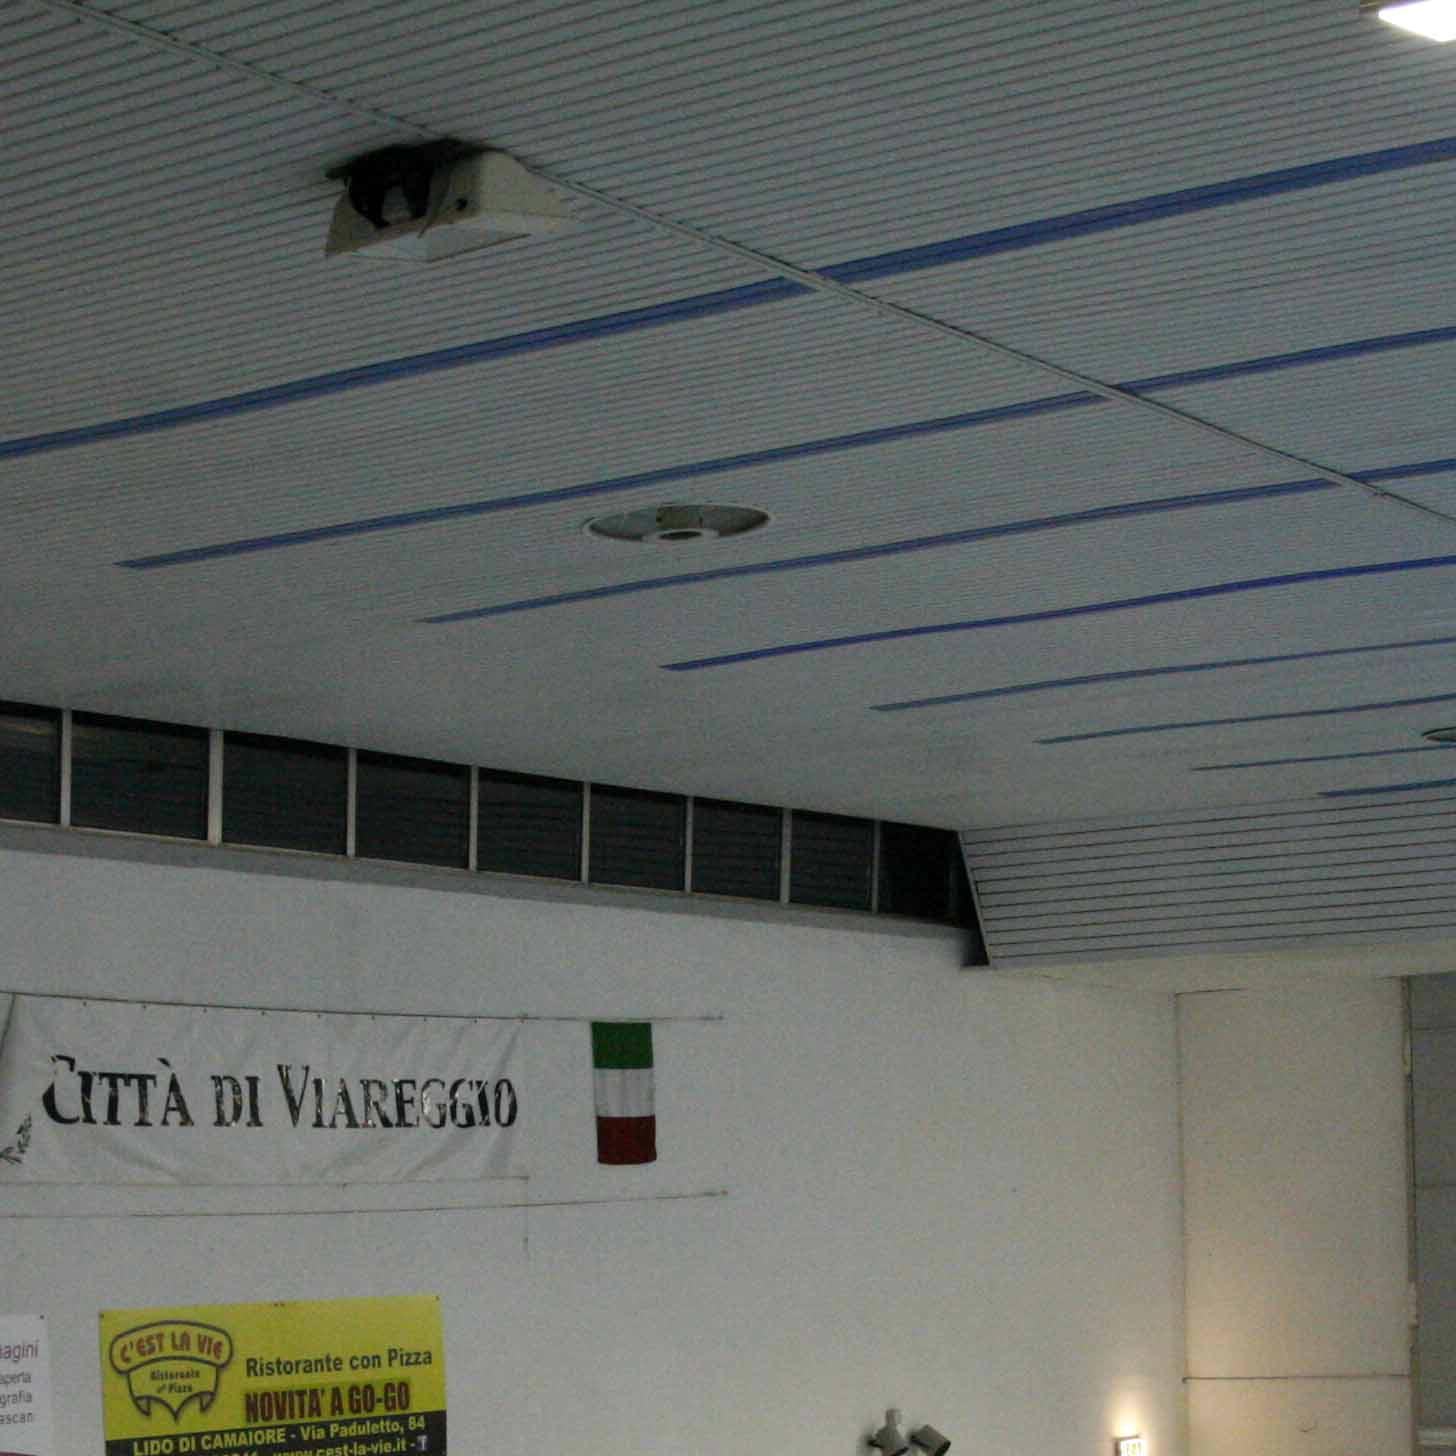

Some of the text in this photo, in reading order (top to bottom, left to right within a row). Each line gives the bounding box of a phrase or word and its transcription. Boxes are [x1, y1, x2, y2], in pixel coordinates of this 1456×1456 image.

[42, 1055, 518, 1129] CITTÀ DI VIAREGGIO
[171, 1331, 191, 1351] LA
[246, 1348, 433, 1377] Ristorante con Pizza
[246, 1381, 411, 1424] NOVITA' A GO-GO
[133, 1439, 174, 1456] LIDO
[179, 1436, 195, 1453] DI
[200, 1428, 287, 1450] CAMAIORE
[300, 1425, 326, 1441] Via
[329, 1418, 405, 1438] Paduletto,
[408, 1415, 426, 1431] 84
